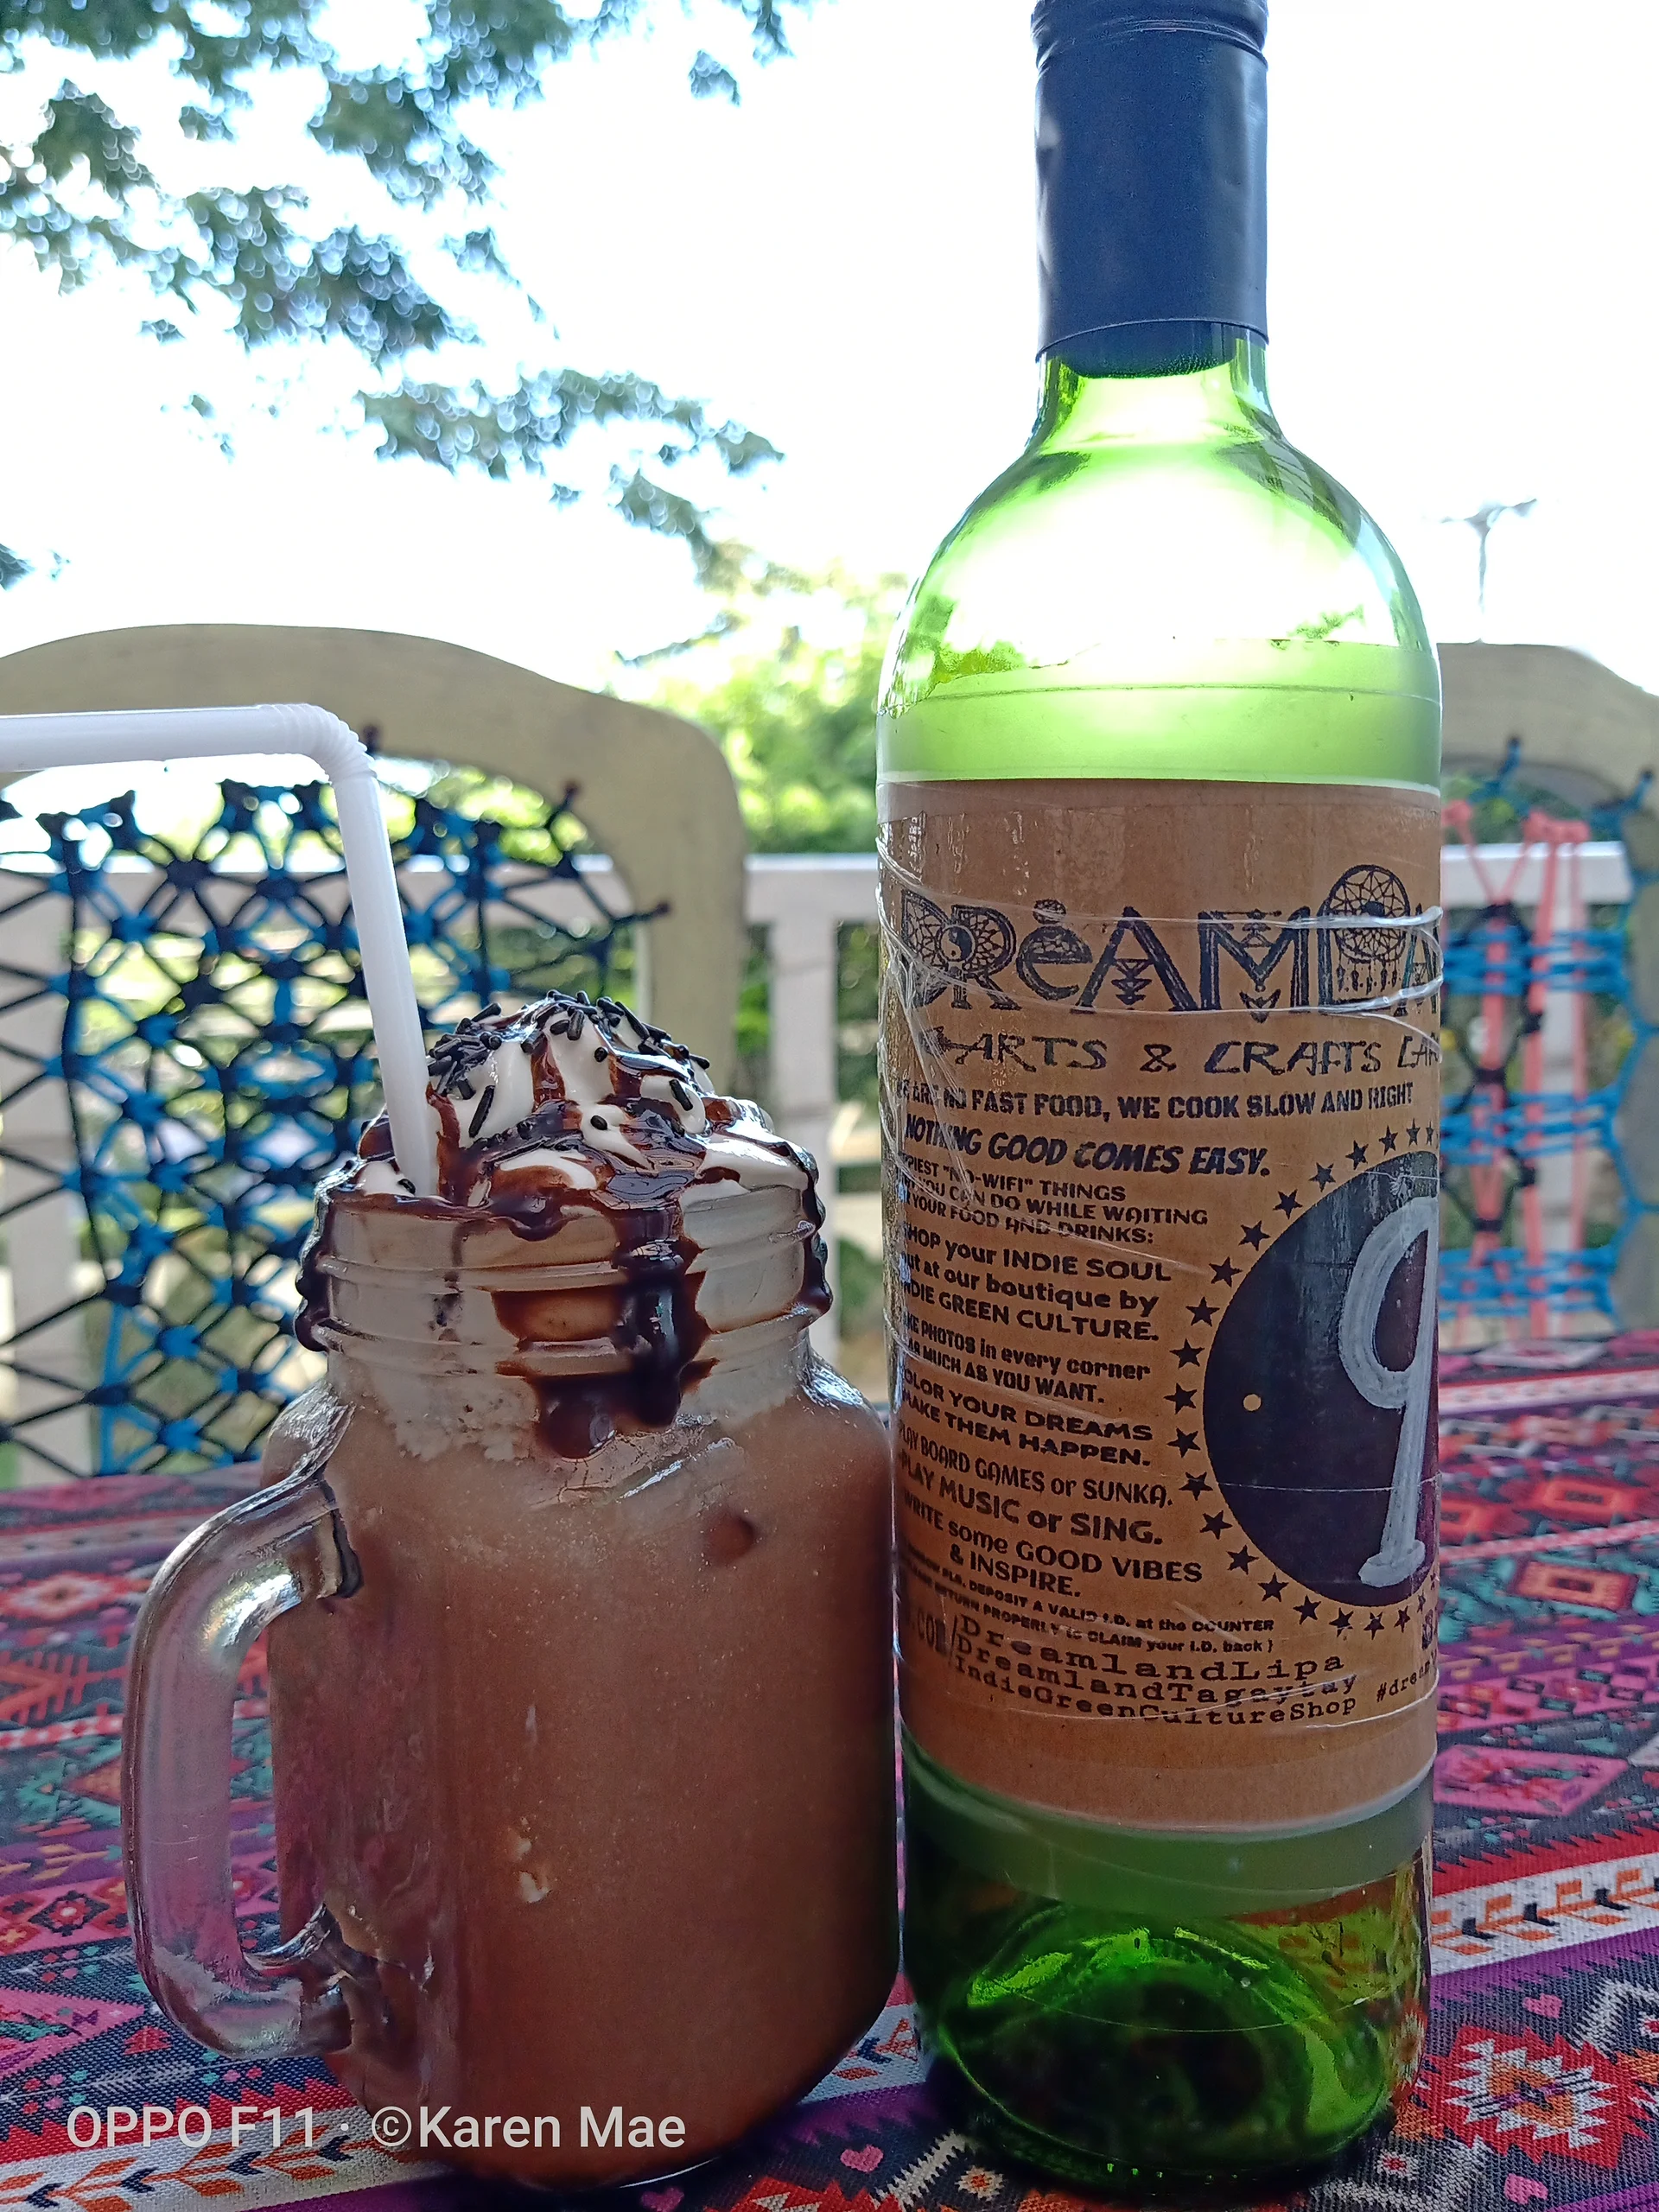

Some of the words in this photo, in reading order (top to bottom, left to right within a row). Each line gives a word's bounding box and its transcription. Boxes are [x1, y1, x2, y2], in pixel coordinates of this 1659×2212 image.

[954, 1033, 1108, 1072] ARTS
[1139, 1043, 1177, 1073] &
[1204, 1039, 1382, 1077] CRAFTS
[972, 1089, 1027, 1116] FAST
[1034, 1092, 1109, 1122] FOOD,
[1117, 1096, 1160, 1120] WE
[1167, 1095, 1240, 1119] COOK
[1246, 1090, 1316, 1117] SLOW
[1320, 1088, 1363, 1114] AND
[1368, 1081, 1414, 1109] RIGHT
[906, 1113, 983, 1156] NOTHING
[988, 1132, 1068, 1166] GOOD
[1073, 1141, 1184, 1174] COMES
[1188, 1147, 1270, 1177] EASY.
[949, 1185, 986, 1207] CAN
[990, 1192, 1021, 1210] DO
[1027, 1198, 1096, 1220] WHILE
[1103, 1205, 1208, 1226] WAITING
[1039, 1179, 1127, 1202] THINGS
[912, 1193, 947, 1218] YOUR
[950, 1205, 1000, 1228] FOOD
[1005, 1216, 1051, 1235] AND
[1058, 1220, 1154, 1244] DRINKS:
[904, 1253, 921, 1273] ut
[924, 1261, 940, 1280] at
[944, 1268, 981, 1291] our
[986, 1272, 1111, 1311] boutique
[1120, 1289, 1160, 1318] by
[945, 1239, 997, 1265] your
[1003, 1248, 1078, 1275] INDIE
[1085, 1257, 1172, 1282] SOUL
[903, 1279, 936, 1305] NDIE
[938, 1291, 1010, 1325] GREEN
[1016, 1309, 1160, 1341] CULTURE.
[921, 1319, 976, 1355] PHOTOS
[979, 1338, 997, 1360] in
[1001, 1347, 1062, 1376] every
[1066, 1357, 1151, 1381] corner
[922, 1345, 962, 1375] MUCH
[964, 1361, 988, 1382] AS
[993, 1368, 1031, 1392] YOU
[1034, 1376, 1105, 1403] WANT.
[904, 1367, 945, 1402] OLOR
[948, 1389, 1018, 1424] YOUR
[1025, 1409, 1154, 1440] DREAMS
[944, 1411, 1012, 1447] THEM
[1018, 1432, 1152, 1466] HAPPEN.
[920, 1435, 971, 1473] BOARD
[974, 1457, 1046, 1494] GAMES
[1050, 1478, 1077, 1497] or
[1083, 1478, 1173, 1509] SUNKA.
[904, 1487, 944, 1531] WRITE
[948, 1519, 1008, 1554] some
[1015, 1540, 1103, 1573] GOOD
[1111, 1554, 1204, 1583] VIBES
[938, 1475, 1022, 1524] MUSIC
[1027, 1510, 1063, 1533] or
[1070, 1512, 1164, 1545] SING.
[949, 1543, 964, 1566] &
[969, 1550, 1081, 1598] INSPIRE.
[969, 1579, 1028, 1607] DEPOSIT
[1033, 1599, 1044, 1612] A
[1047, 1602, 1098, 1622] VALID
[1135, 1618, 1154, 1630] at
[1159, 1618, 1187, 1631] the
[1192, 1618, 1274, 1632] COUNTER
[1087, 1630, 1143, 1649] CLAIM
[1146, 1640, 1185, 1653] your
[1223, 1639, 1263, 1653] back
